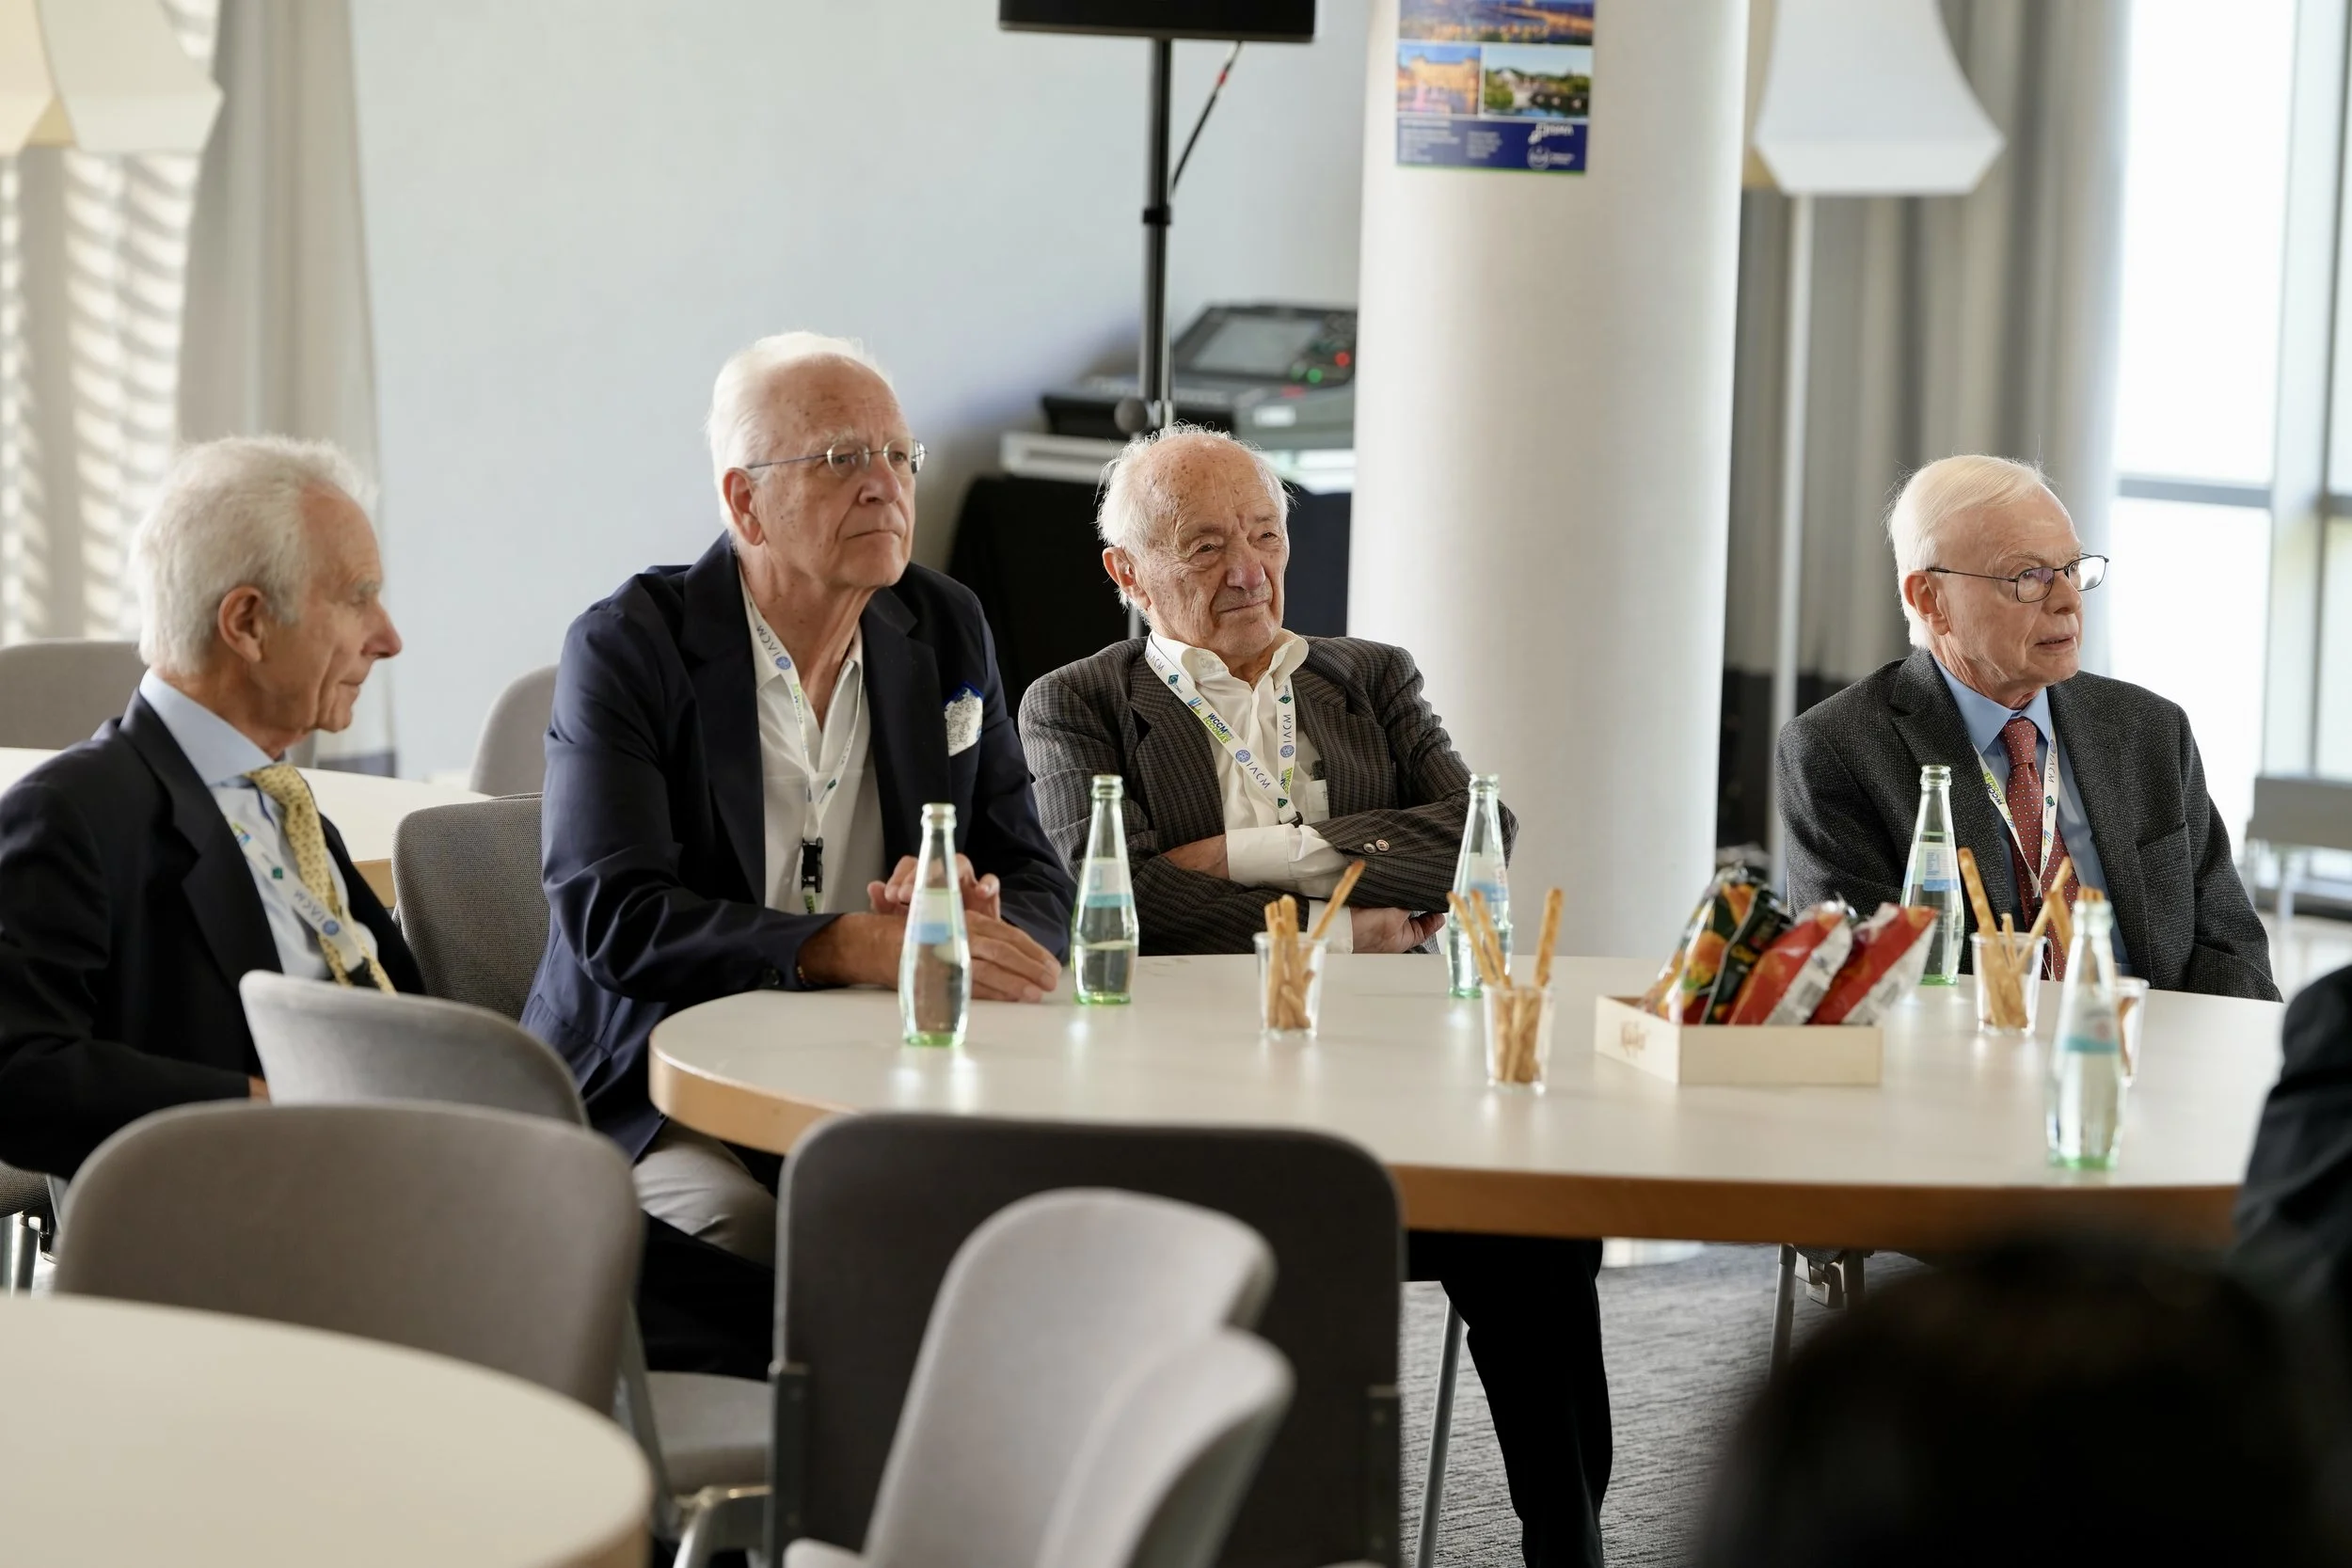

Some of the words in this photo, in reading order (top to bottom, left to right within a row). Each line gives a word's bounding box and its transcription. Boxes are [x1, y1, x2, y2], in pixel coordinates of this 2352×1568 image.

[1202, 717, 1230, 744] ECCOMAS
[1208, 712, 1228, 734] WCCM
[1283, 714, 1292, 743] IACM
[1246, 761, 1271, 789] IACM
